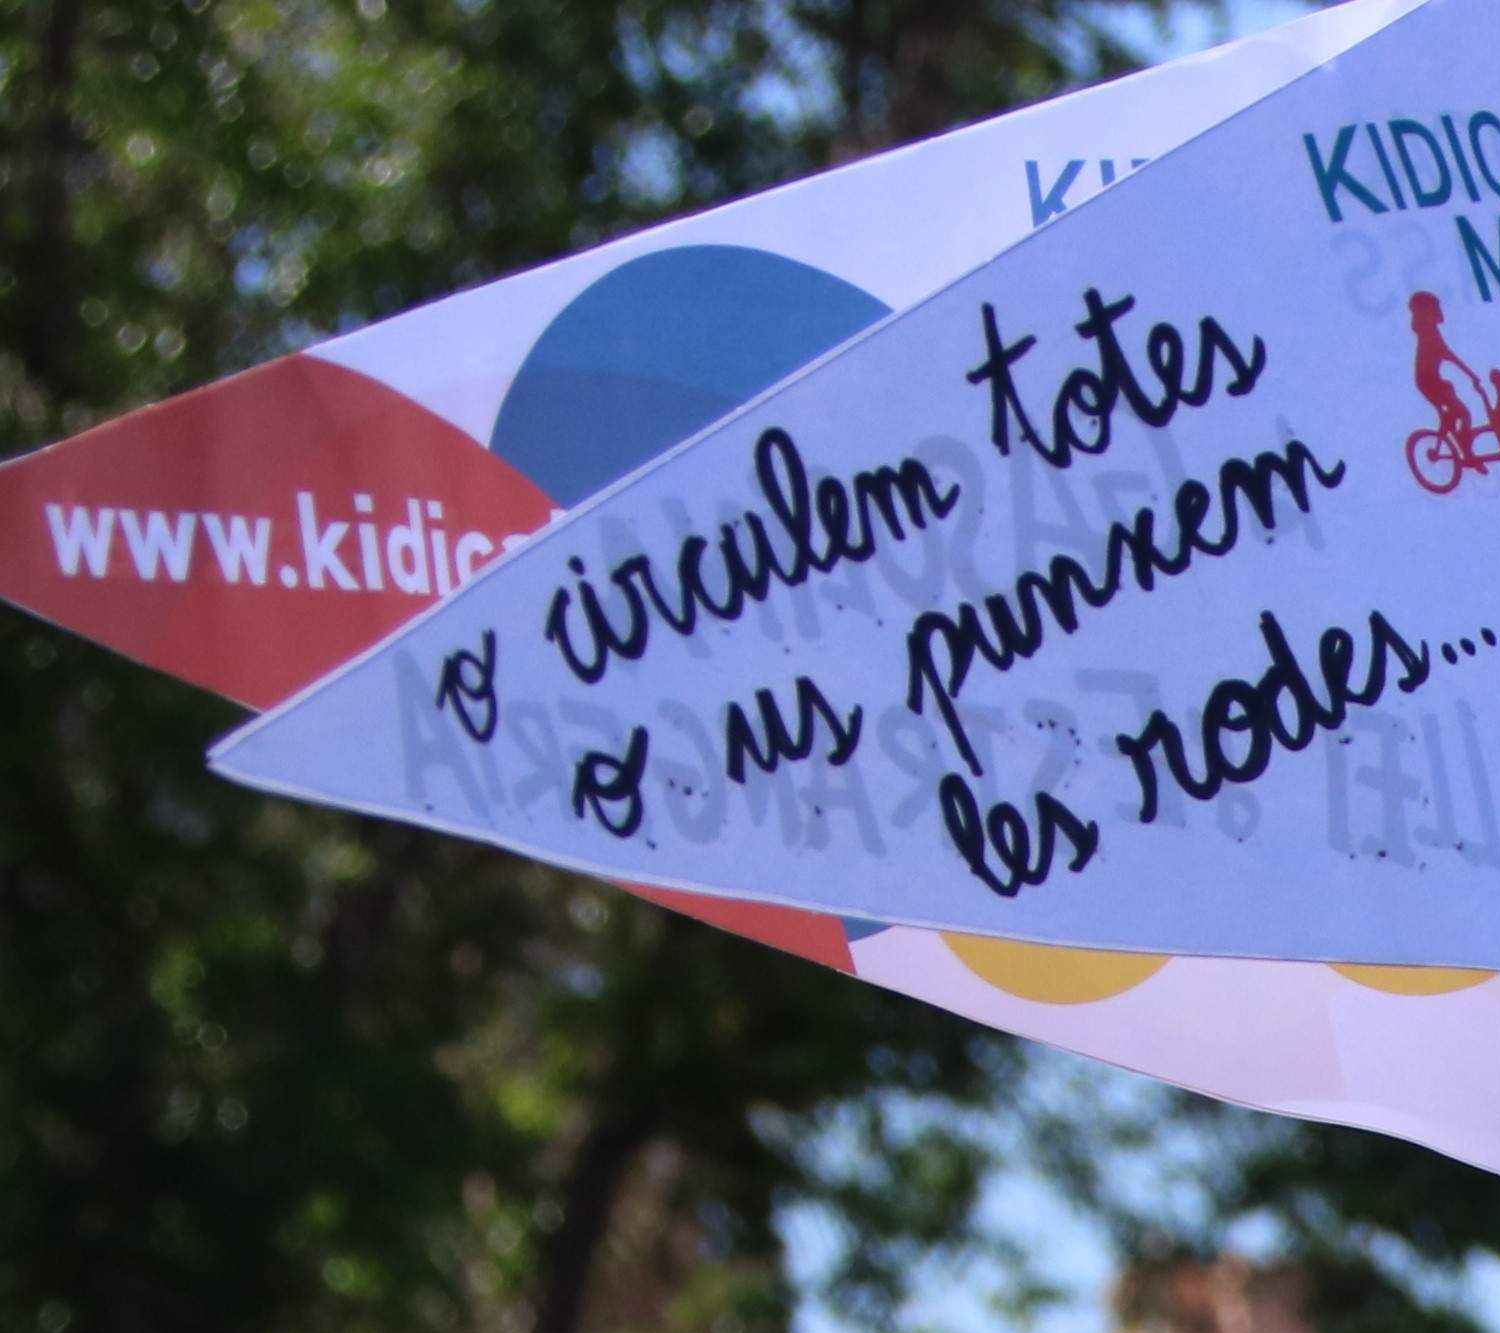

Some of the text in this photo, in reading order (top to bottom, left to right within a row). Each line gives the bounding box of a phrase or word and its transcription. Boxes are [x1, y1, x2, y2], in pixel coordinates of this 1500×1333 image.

[45, 490, 570, 598] www.kidic
[436, 287, 1267, 744] o circulem totes
[571, 725, 649, 839] o
[725, 675, 863, 785] us
[906, 439, 1346, 777] punxem
[938, 772, 1099, 898] les
